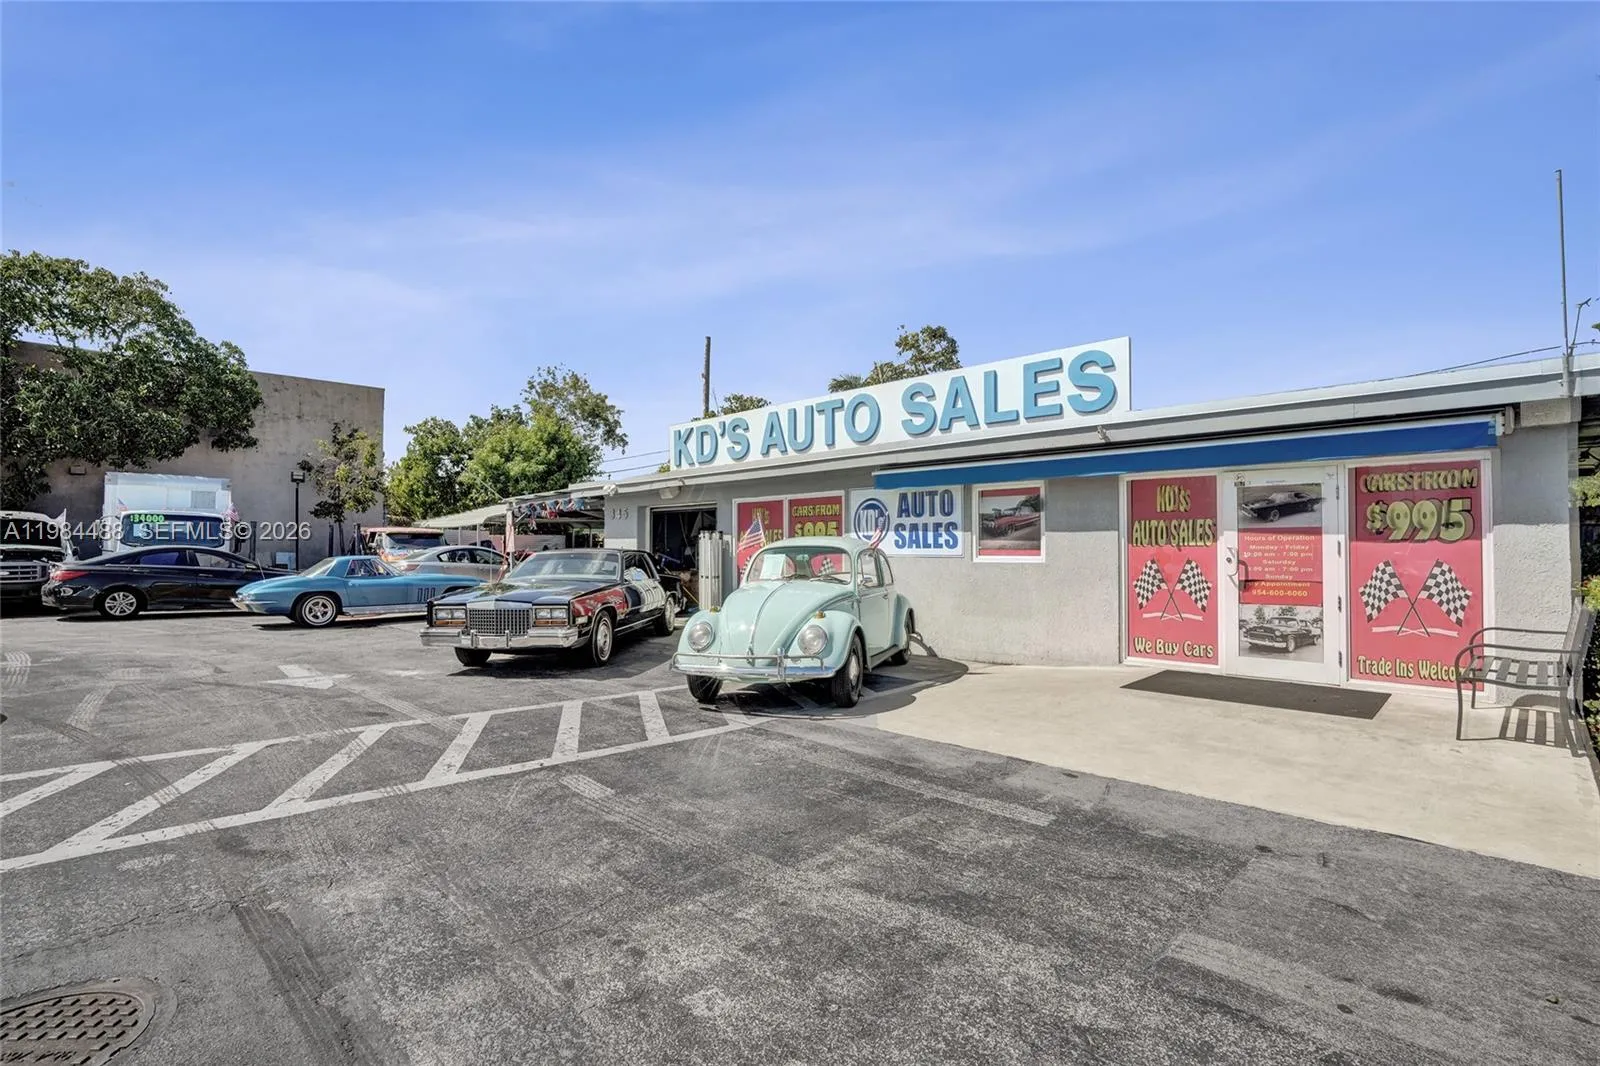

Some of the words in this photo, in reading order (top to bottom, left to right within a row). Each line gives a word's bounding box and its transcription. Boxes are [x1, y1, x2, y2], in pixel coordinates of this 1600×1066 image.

[673, 417, 751, 467] KD'S
[760, 392, 882, 457] AUTO
[900, 349, 1118, 437] SALES
[1361, 472, 1412, 493] CARS
[1413, 467, 1478, 490] FROM
[792, 505, 813, 518] CARS
[815, 504, 840, 517] FROM
[896, 489, 954, 518] AUTO
[893, 521, 959, 550] SALES
[1132, 520, 1169, 547] AUTO
[1170, 518, 1216, 547] SALES
[1366, 498, 1475, 544] $995
[1133, 636, 1153, 654] We
[1155, 638, 1179, 656] Buy
[1182, 640, 1214, 658] Cars
[1357, 655, 1393, 677] Trade
[1395, 658, 1415, 679] Ins
